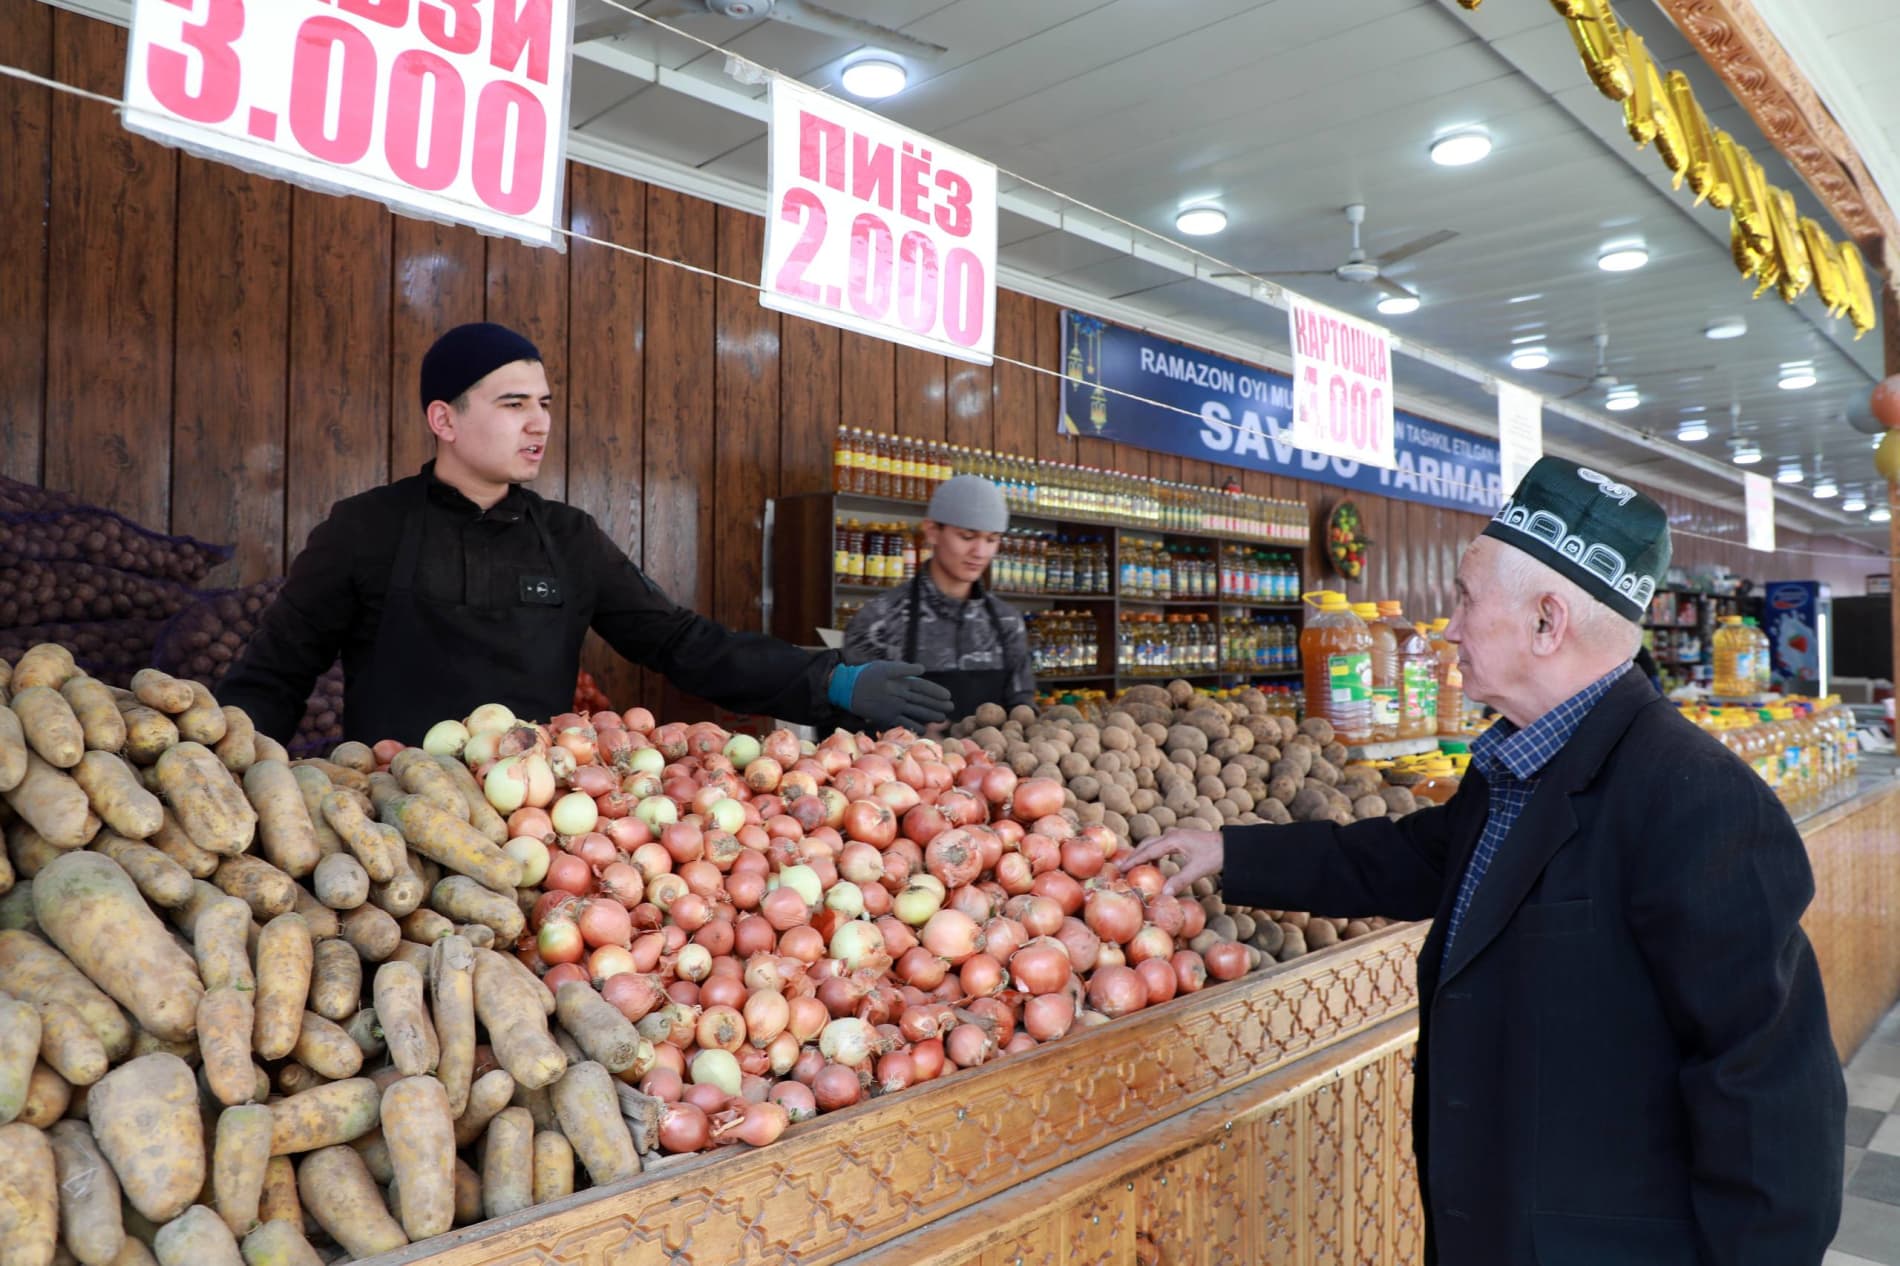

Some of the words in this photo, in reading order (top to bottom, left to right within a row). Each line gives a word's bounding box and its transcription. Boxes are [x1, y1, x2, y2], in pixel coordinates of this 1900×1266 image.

[147, 0, 547, 216] 3.000
[799, 110, 973, 238] ПИЁЗ
[775, 187, 985, 347] 2.000
[1141, 347, 1234, 394] RAMAZON
[1238, 375, 1267, 403] OYI
[1294, 306, 1387, 383] КАРТОШКА
